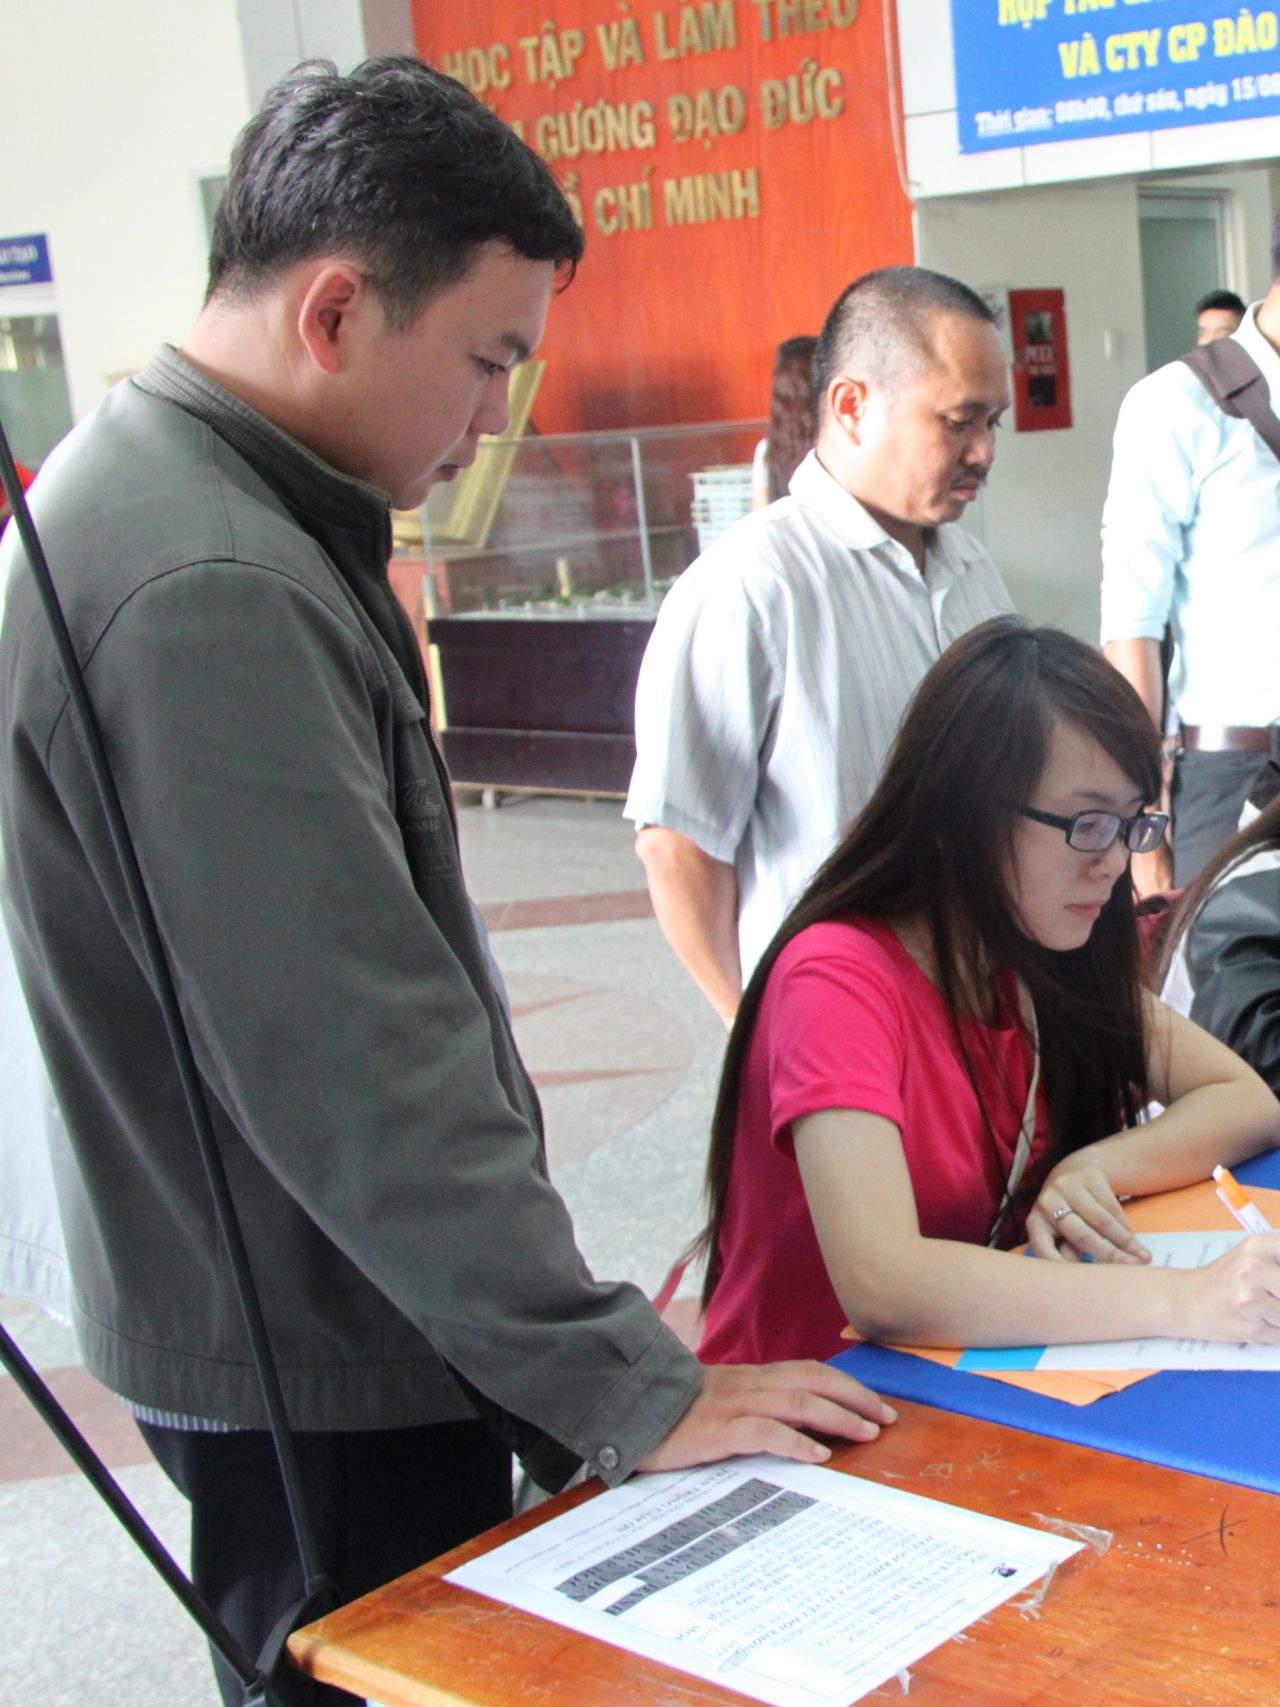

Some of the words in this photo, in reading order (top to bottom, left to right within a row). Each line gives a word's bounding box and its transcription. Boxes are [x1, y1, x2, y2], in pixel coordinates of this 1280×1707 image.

[518, 20, 584, 90] TẬP
[597, 4, 645, 71] VÀ
[1058, 32, 1101, 79] VÀ
[1105, 28, 1161, 72] CTY
[1167, 22, 1207, 63] CP
[1213, 8, 1278, 57] ĐÀO
[668, 83, 745, 151] ĐẠO
[760, 57, 843, 130] ĐỨC
[594, 164, 652, 236] CHÍ
[662, 168, 760, 227] MINH
